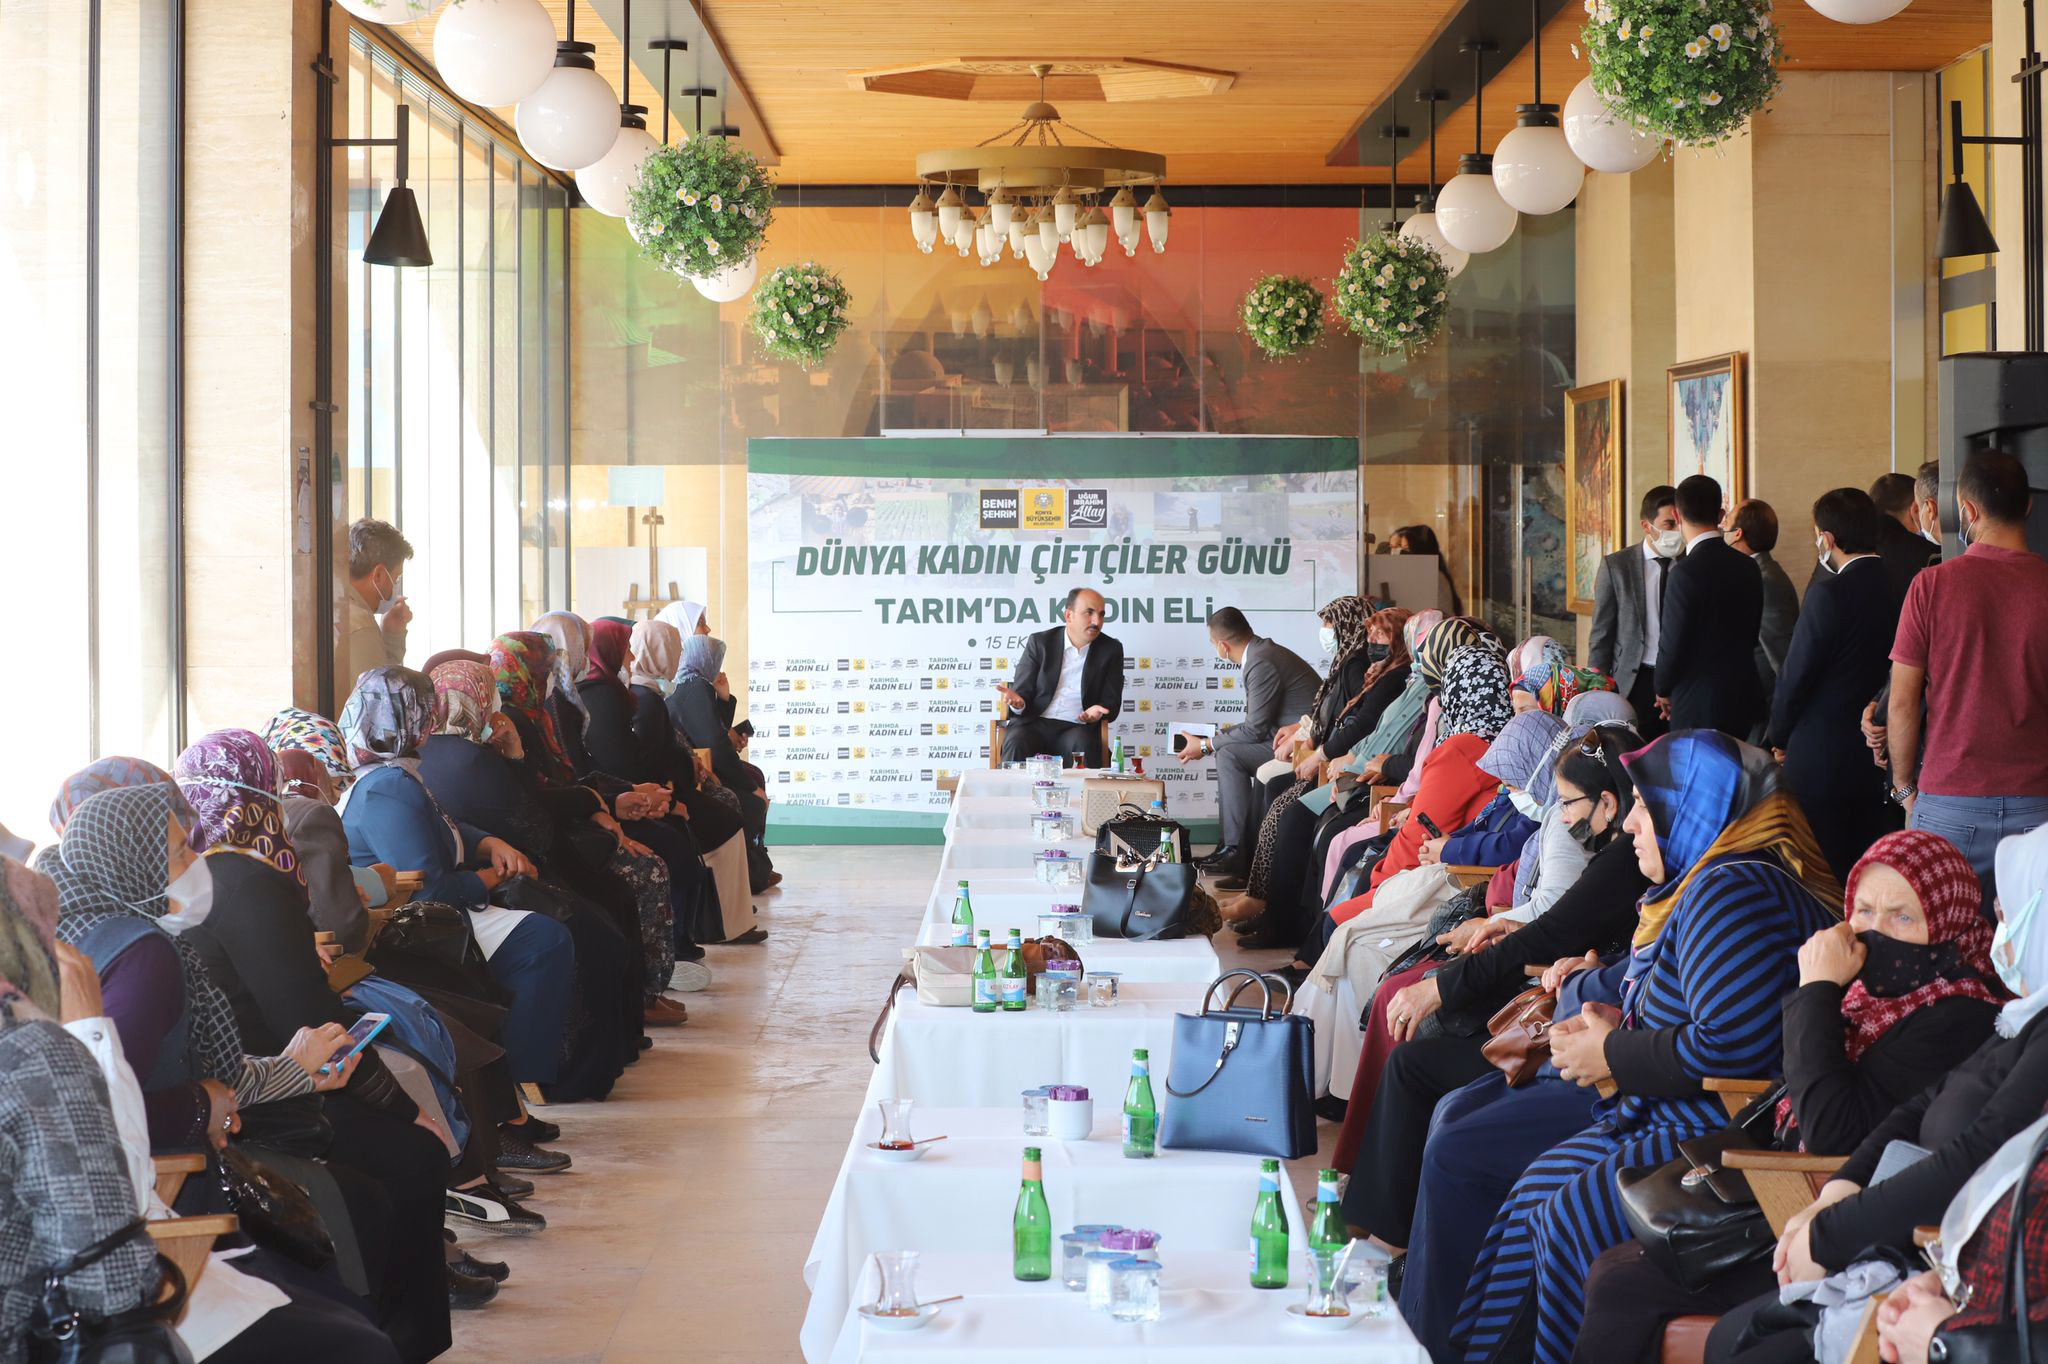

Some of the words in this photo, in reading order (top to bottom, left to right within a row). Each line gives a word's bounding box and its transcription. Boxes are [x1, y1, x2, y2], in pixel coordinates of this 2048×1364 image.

[1070, 505, 1105, 522] Altay
[796, 538, 906, 576] DÜNYA
[917, 545, 1021, 574] KADIN
[1031, 537, 1188, 584] ÇİFTÇİLER
[1198, 538, 1291, 575] GÜNÜ
[875, 598, 1041, 624] TARIM'DA
[1050, 598, 1154, 623] KDIN
[984, 636, 1002, 649] 15
[816, 664, 829, 672] ELİ
[957, 662, 972, 670] ELİ
[869, 682, 897, 690] KADIN
[898, 682, 913, 690] ELİ
[1184, 681, 1198, 689] ELİ
[816, 706, 829, 714] ELİ
[957, 704, 972, 713] ELİ
[756, 730, 770, 738] ELİ
[869, 728, 897, 736] KADIN
[898, 727, 913, 736] ELİ
[816, 752, 829, 760] ELİ
[957, 750, 972, 758] ELİ
[869, 774, 897, 782] KADIN
[898, 773, 913, 782] ELİ
[1184, 772, 1198, 781] ELİ
